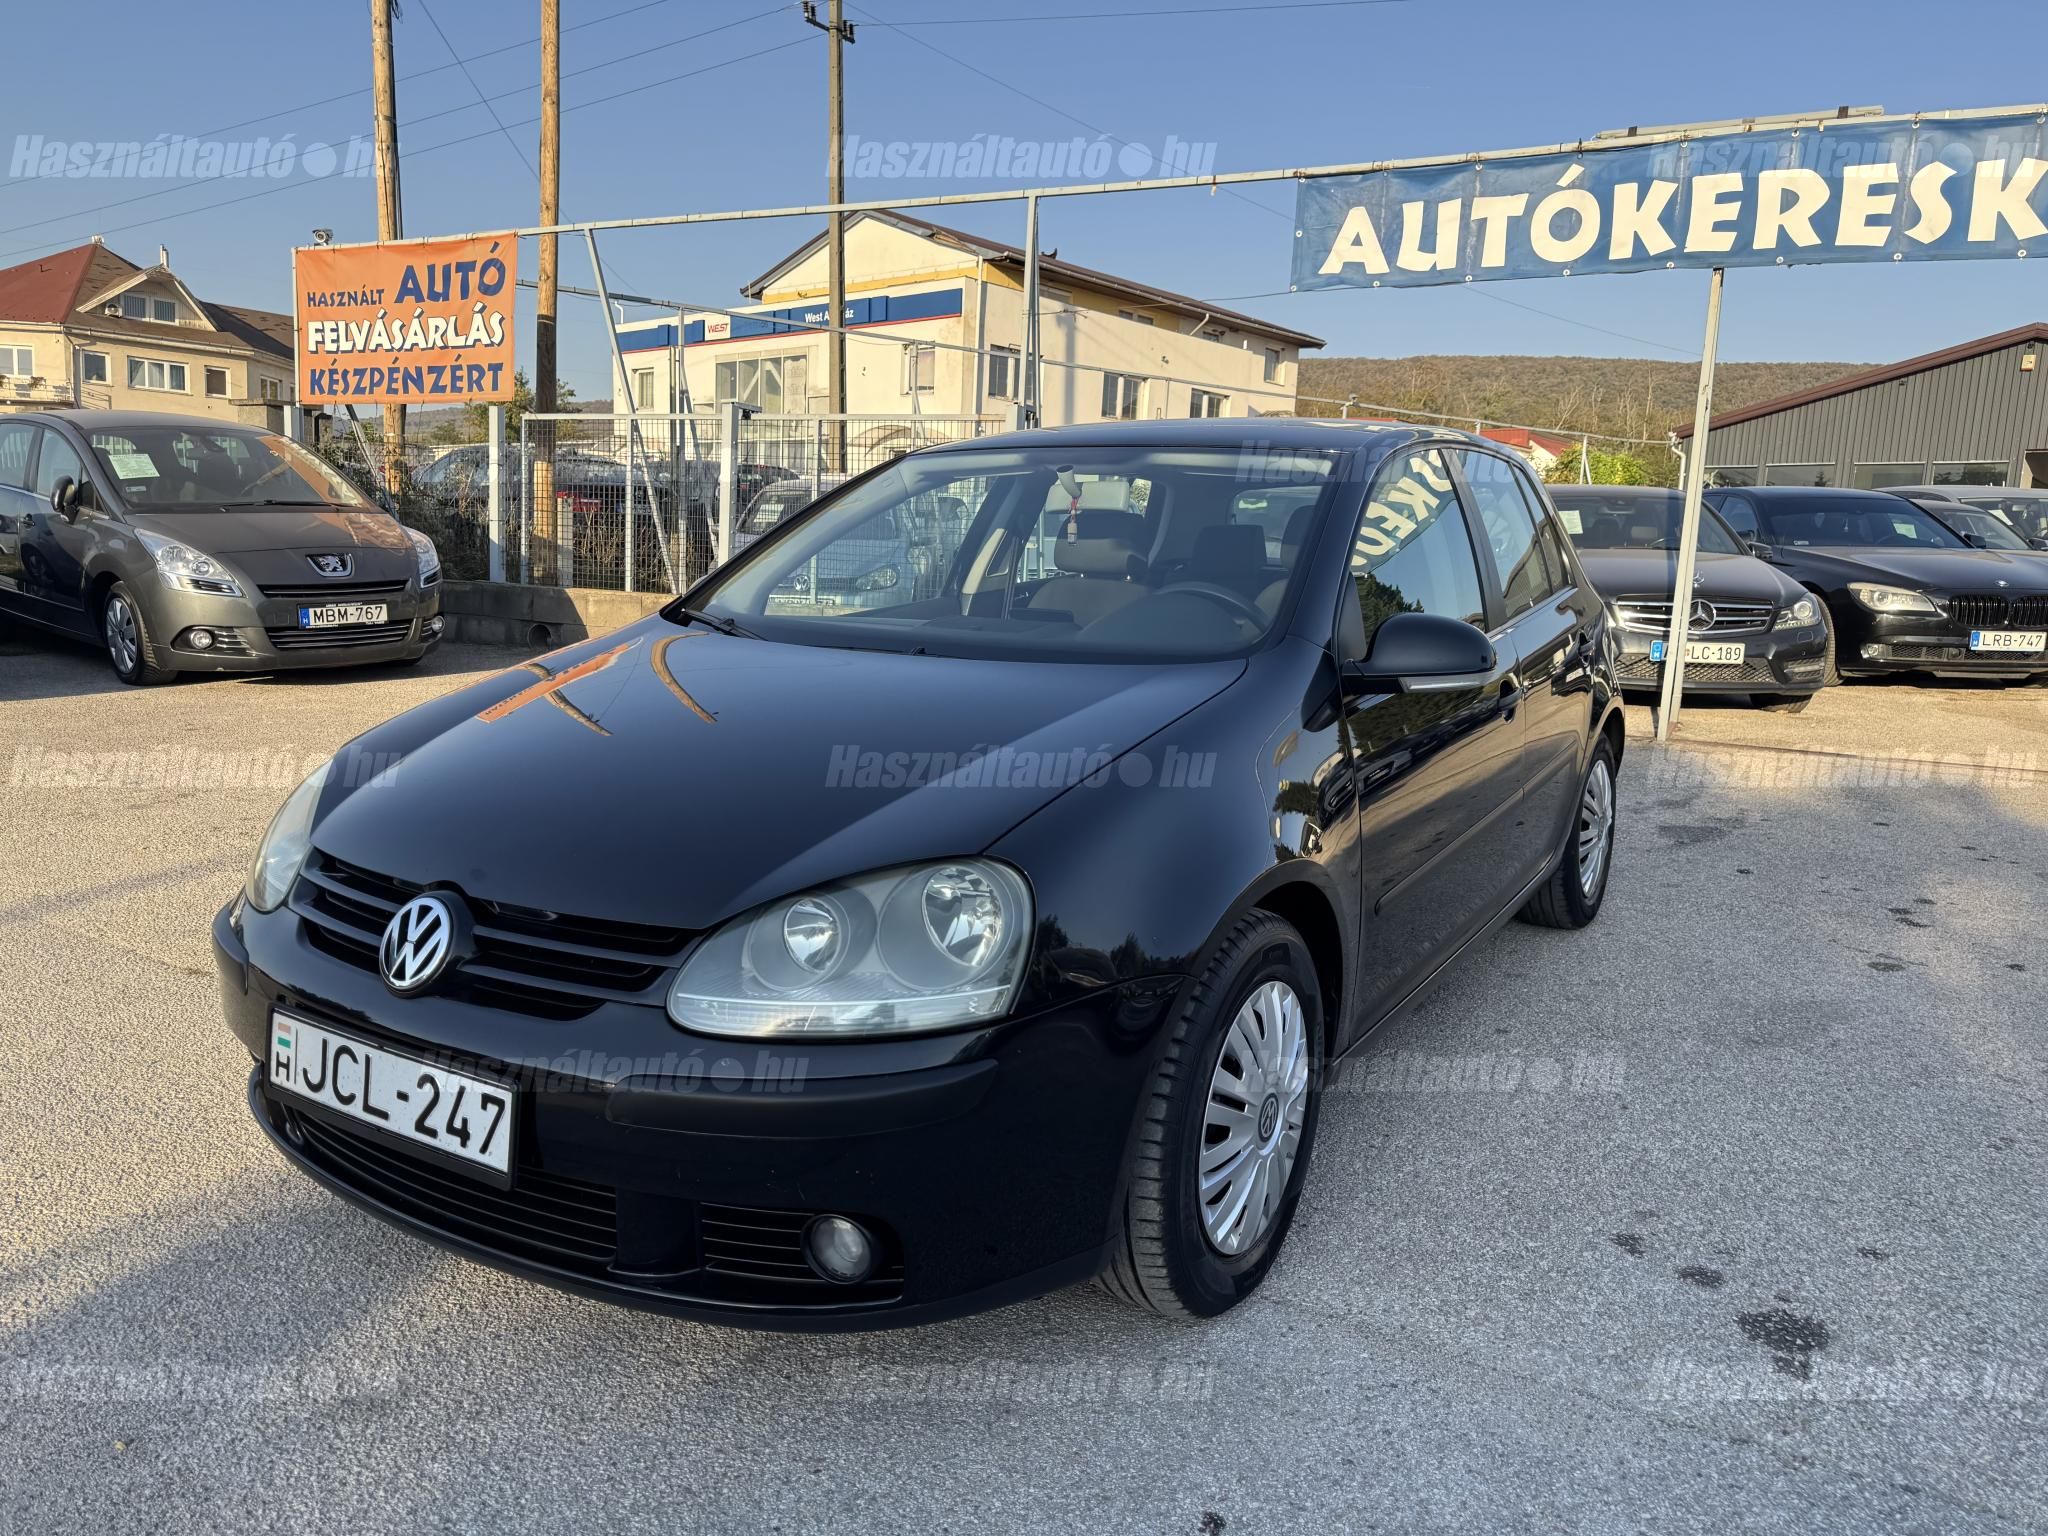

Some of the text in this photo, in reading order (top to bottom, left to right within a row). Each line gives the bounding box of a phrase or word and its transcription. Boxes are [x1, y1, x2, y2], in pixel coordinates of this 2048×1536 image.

[1318, 157, 2048, 275] AUTÓKERESK
[307, 241, 506, 307] HASZNÁLT AUTÓ
[307, 301, 504, 354] FELVÁSÁRLÁS
[707, 322, 729, 334] WEST
[805, 311, 823, 323] West
[310, 353, 504, 396] KÉSZPÉNZÉRT
[313, 606, 383, 624] MBM-767
[1691, 645, 1742, 661] LC-189
[1982, 633, 2043, 648] LRB-747
[275, 1037, 506, 1155] H JCL-247
